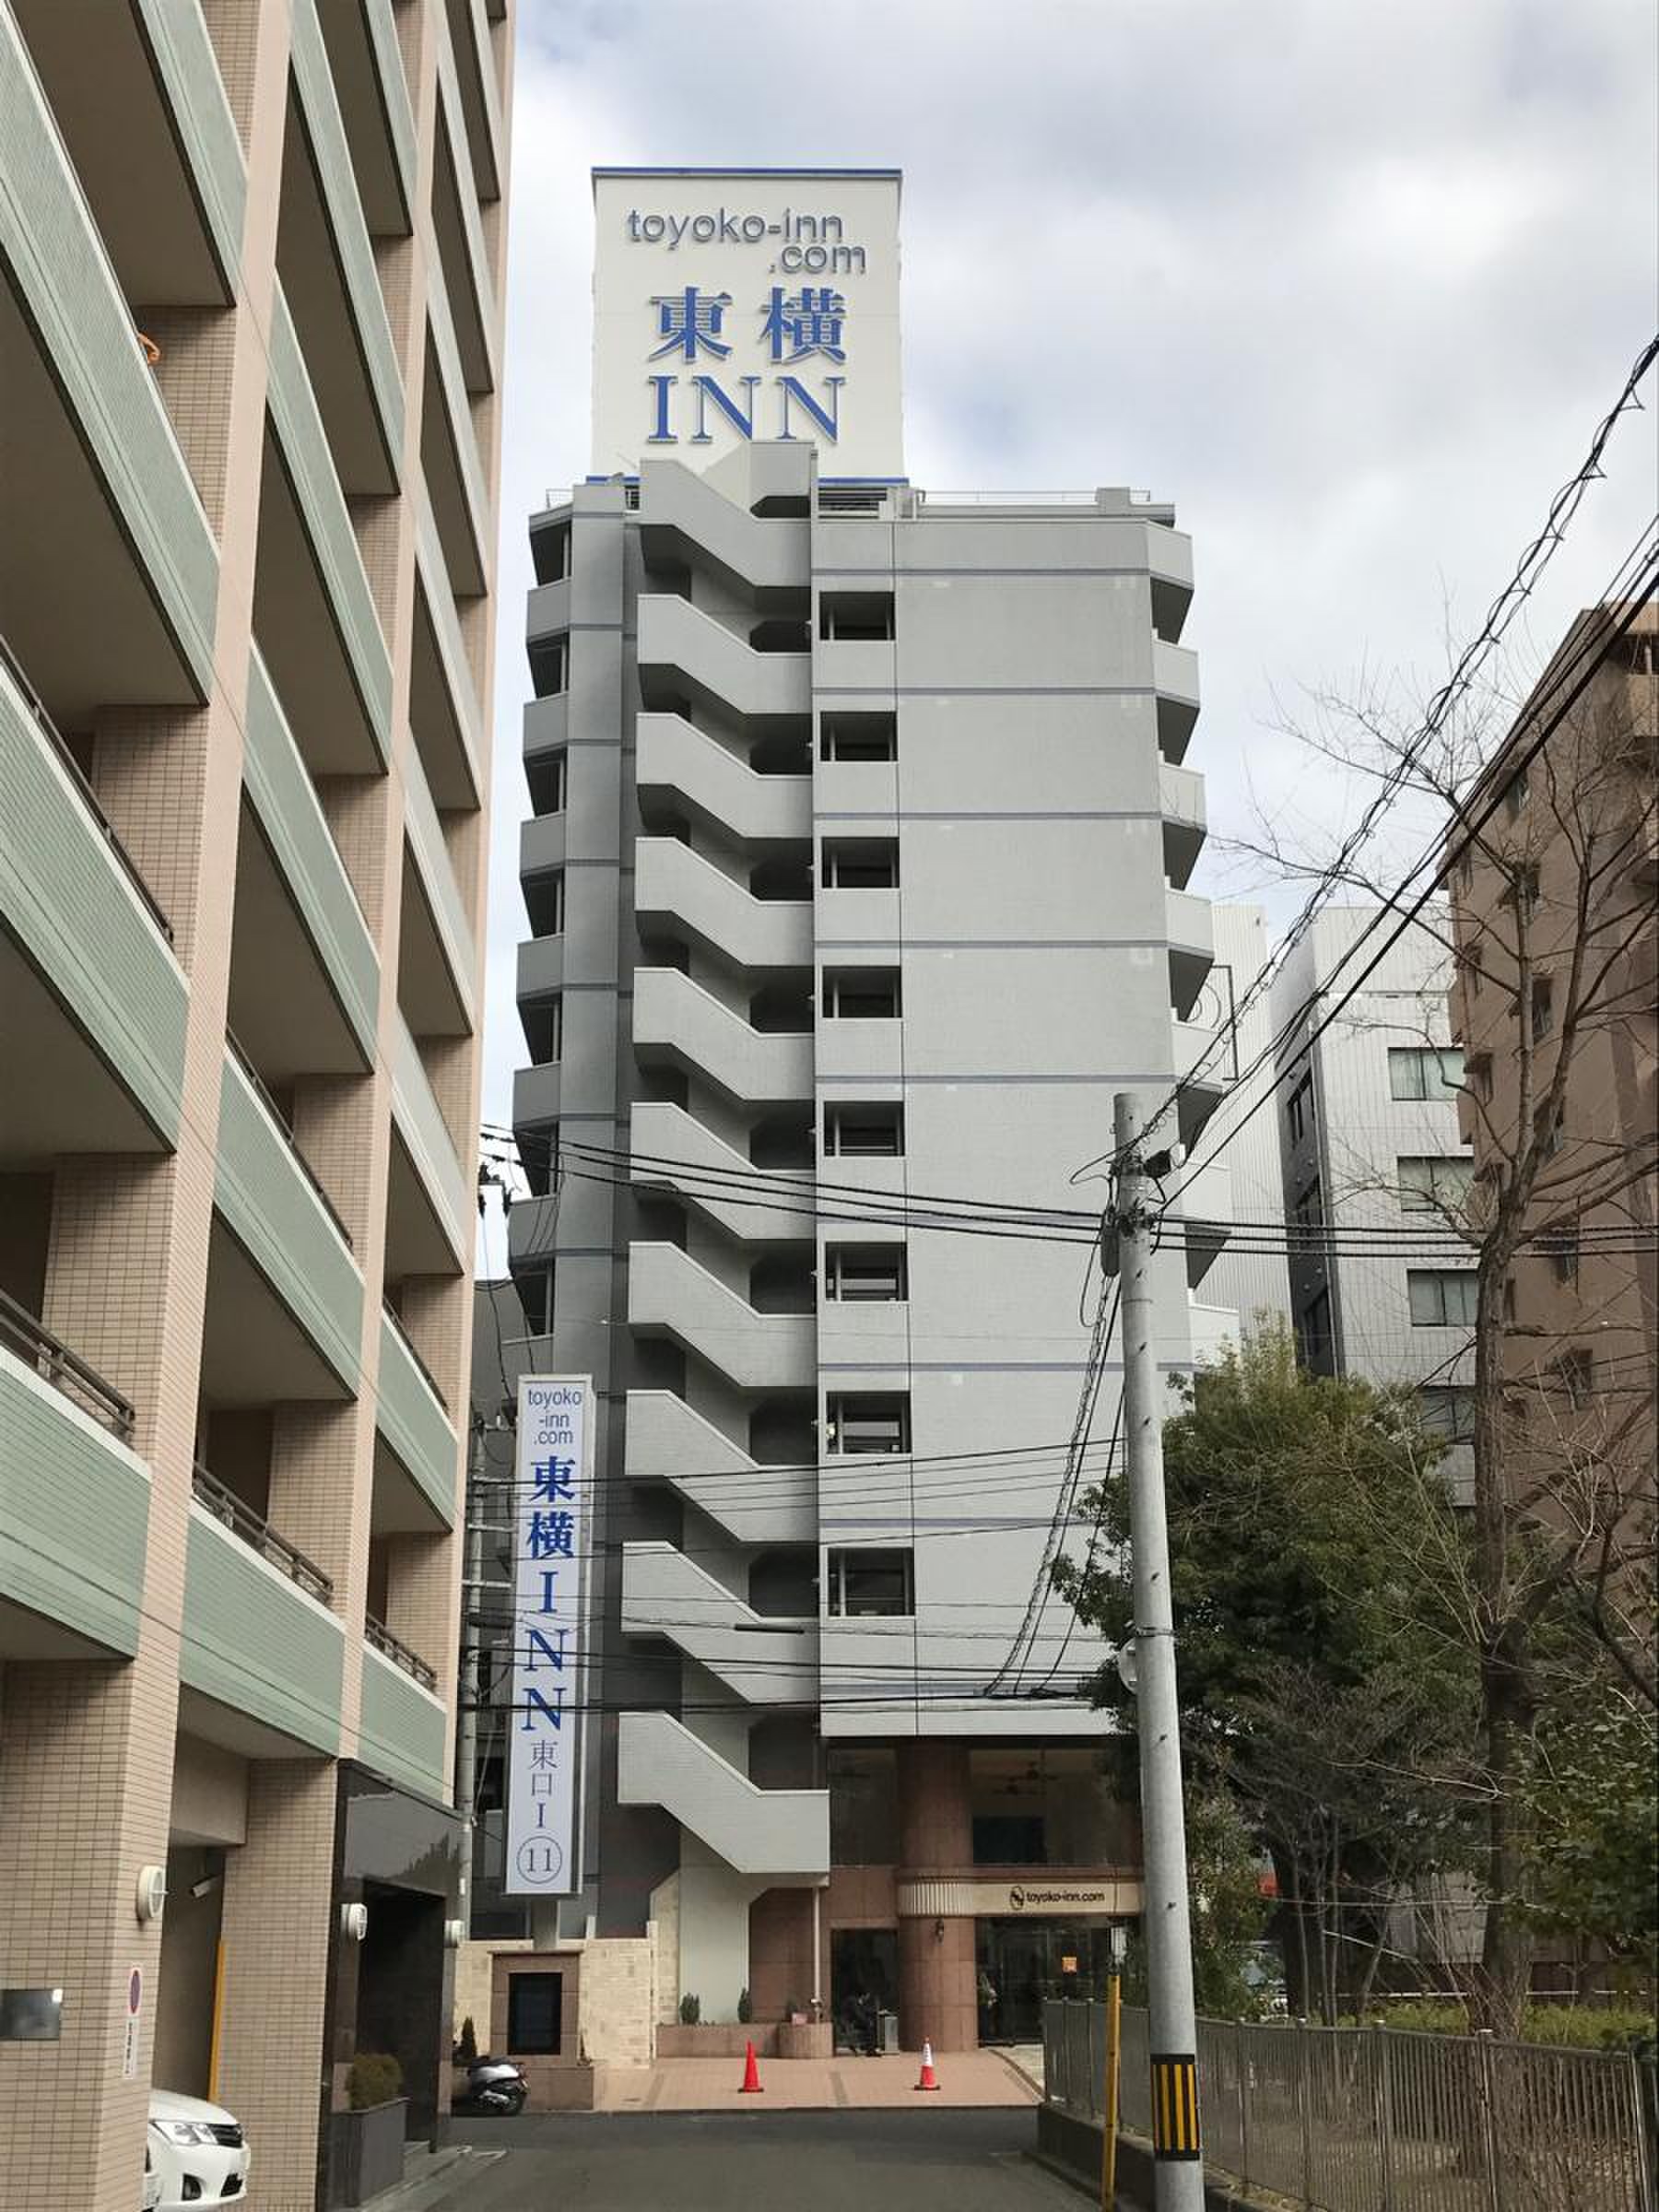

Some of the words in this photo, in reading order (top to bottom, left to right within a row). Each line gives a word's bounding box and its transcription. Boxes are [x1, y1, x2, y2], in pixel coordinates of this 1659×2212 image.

[628, 207, 843, 251] toyoko-inn
[768, 245, 866, 275] .com
[646, 286, 847, 366] 東横
[646, 375, 846, 444] INN
[528, 1388, 582, 1409] toyoko
[538, 1414, 570, 1428] -inn
[534, 1430, 573, 1445] .com
[1026, 1890, 1105, 1905] toyoko-inn.com
